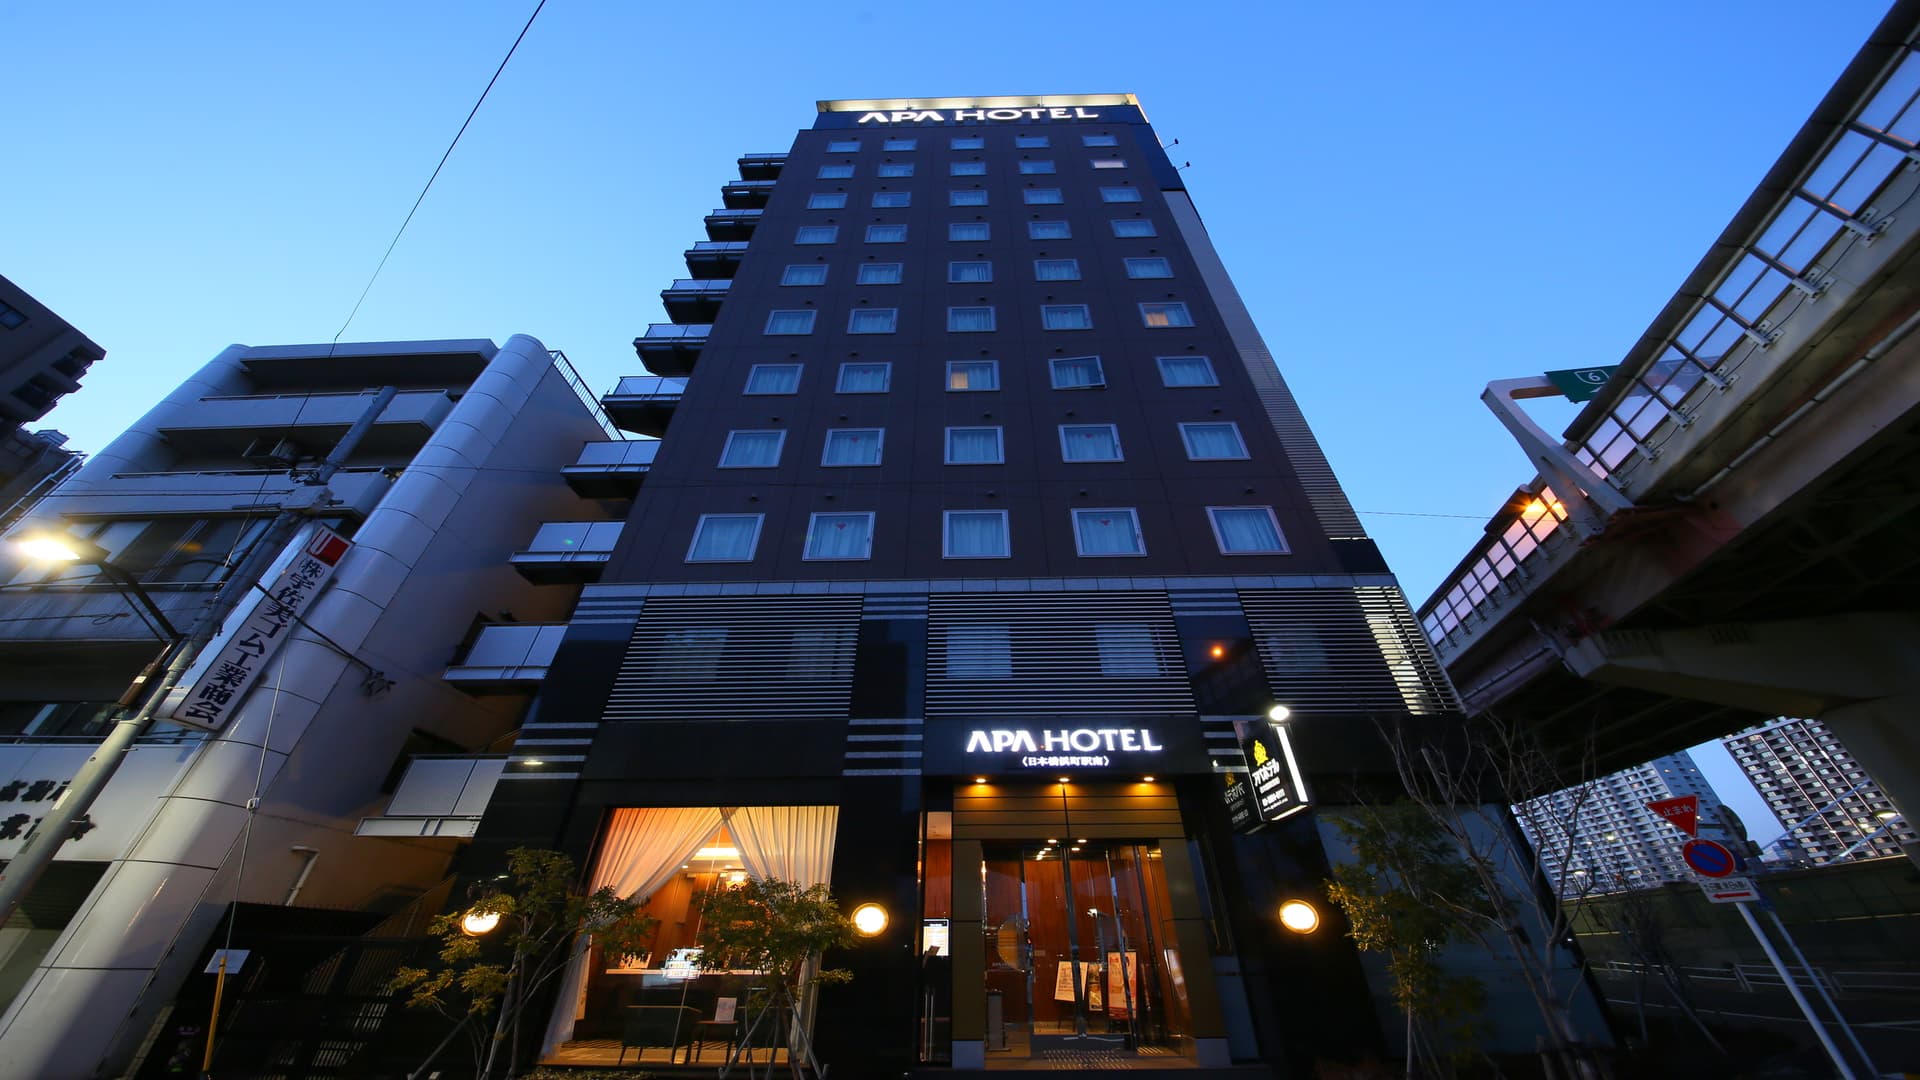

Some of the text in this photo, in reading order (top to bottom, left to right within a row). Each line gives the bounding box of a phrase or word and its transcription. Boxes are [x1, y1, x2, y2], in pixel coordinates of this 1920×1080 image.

[857, 107, 1100, 124] APA HOTEL
[1589, 372, 1601, 382] 6
[966, 728, 1164, 753] APA HOTEL
[1663, 804, 1694, 817] 止まれ
